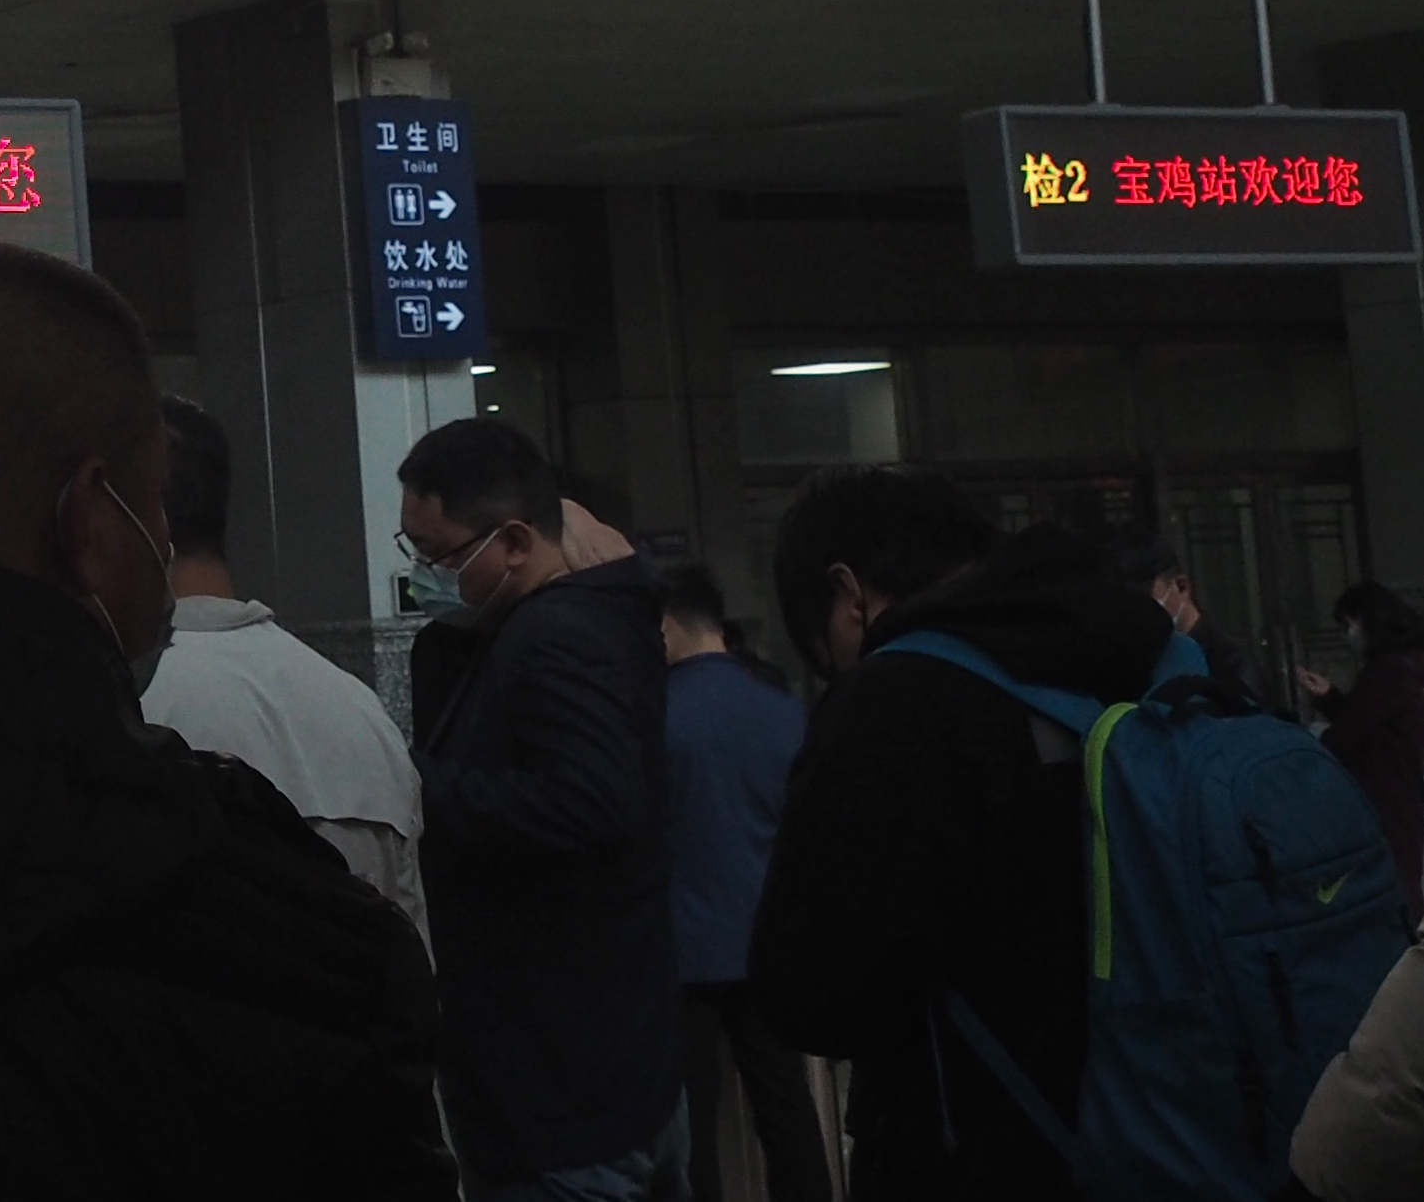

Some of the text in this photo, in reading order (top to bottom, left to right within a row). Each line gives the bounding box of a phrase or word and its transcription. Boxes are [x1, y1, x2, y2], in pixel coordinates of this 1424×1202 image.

[376, 121, 460, 153] 卫生间
[402, 159, 439, 174] Toilet
[1020, 152, 1365, 209] 检2 宝鸡站欢迎您
[383, 239, 469, 272] 饮水处
[388, 276, 468, 292] Drinking Water
